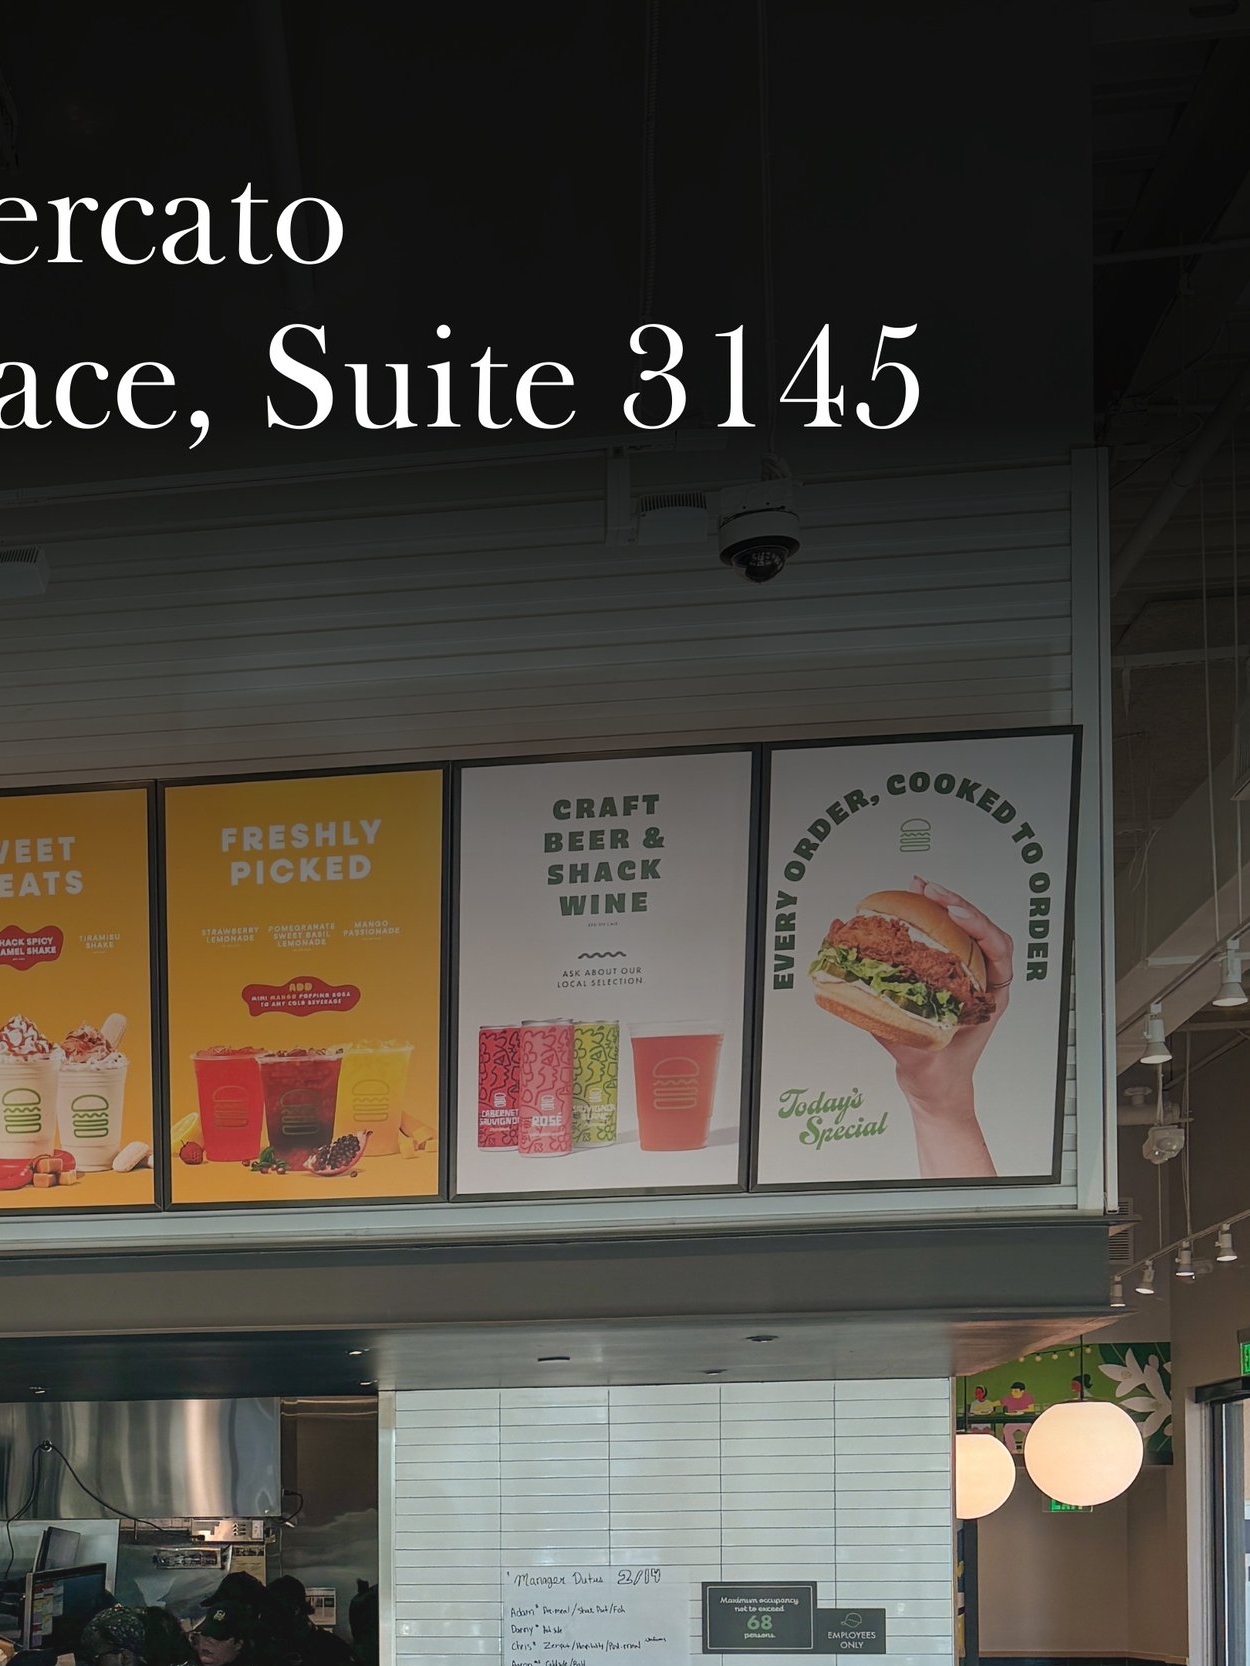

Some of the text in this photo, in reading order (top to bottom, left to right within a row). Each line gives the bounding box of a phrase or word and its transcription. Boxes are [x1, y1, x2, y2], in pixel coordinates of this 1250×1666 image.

[552, 793, 659, 820] CRAFT
[221, 818, 382, 852] FRESHLY
[544, 826, 665, 853] BEER &
[230, 854, 372, 886] PICKED
[547, 858, 662, 885] SHACK
[773, 771, 1051, 990] EVERY ORDER, COOKED TO ORDER
[559, 891, 648, 916] WINE
[268, 922, 336, 933] POMEGRANATE
[354, 919, 390, 929] MANGO
[201, 926, 260, 937] STRAWBERRY
[273, 930, 331, 941] SWEET BASIL
[343, 927, 401, 937] PASSIONADE
[26, 936, 54, 946] SPICY
[79, 933, 120, 942] TIRAMISU
[206, 935, 255, 944] LEMONADE
[277, 938, 327, 948] LEMONADE
[26, 945, 57, 955] SHAKE
[85, 941, 115, 949] SHAKE
[562, 966, 642, 978] ASK ABOUT OUR
[289, 983, 313, 993] ADD
[557, 979, 587, 989] LOCAL
[777, 1087, 865, 1125] Today's
[531, 1112, 563, 1127] ROSÉ
[799, 1111, 889, 1151] Special
[514, 1572, 566, 1590] Manager
[719, 1596, 799, 1606] Maximum occupancy
[734, 1605, 785, 1613] not to exceed
[746, 1614, 773, 1631] 68
[827, 1631, 877, 1640] EMPLOYEES
[840, 1641, 865, 1650] ONLY
